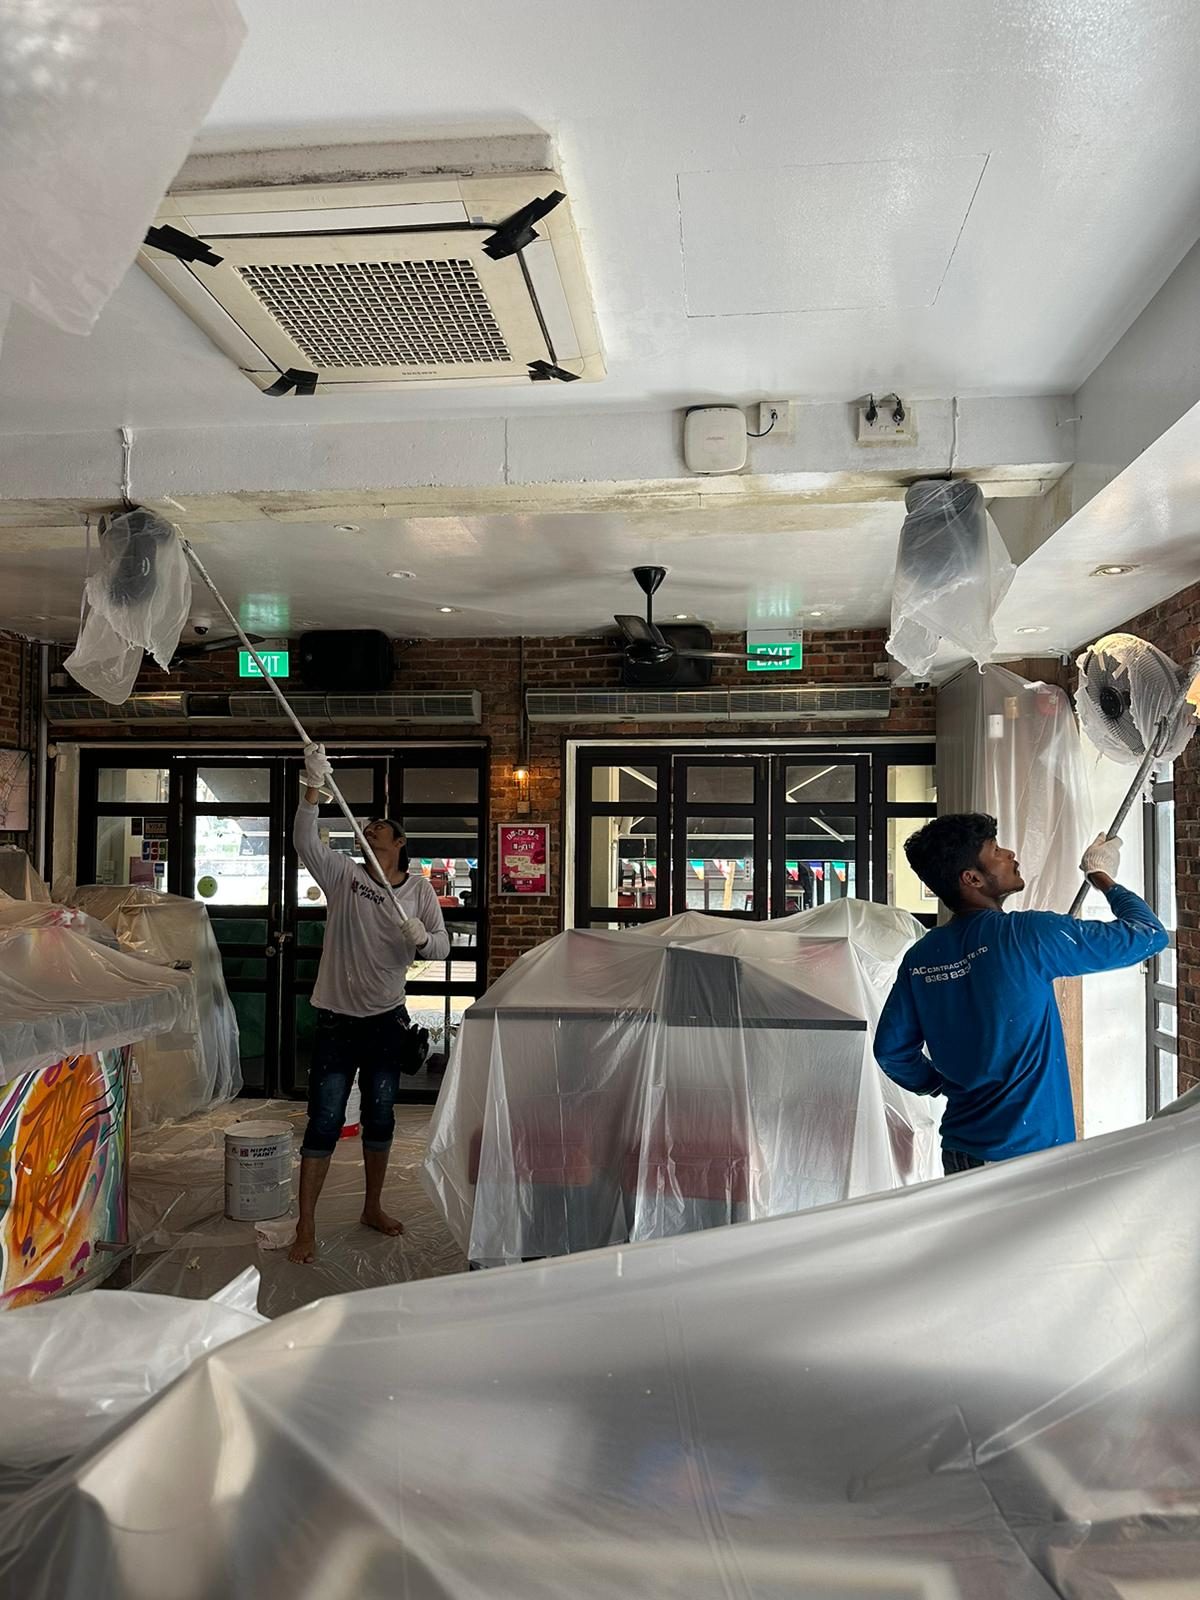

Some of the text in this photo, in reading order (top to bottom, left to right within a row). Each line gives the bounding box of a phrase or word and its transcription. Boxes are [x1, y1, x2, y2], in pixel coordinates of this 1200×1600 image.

[248, 656, 280, 673] EXIT
[756, 647, 792, 666] EXIT
[250, 1145, 277, 1153] NIPPON
